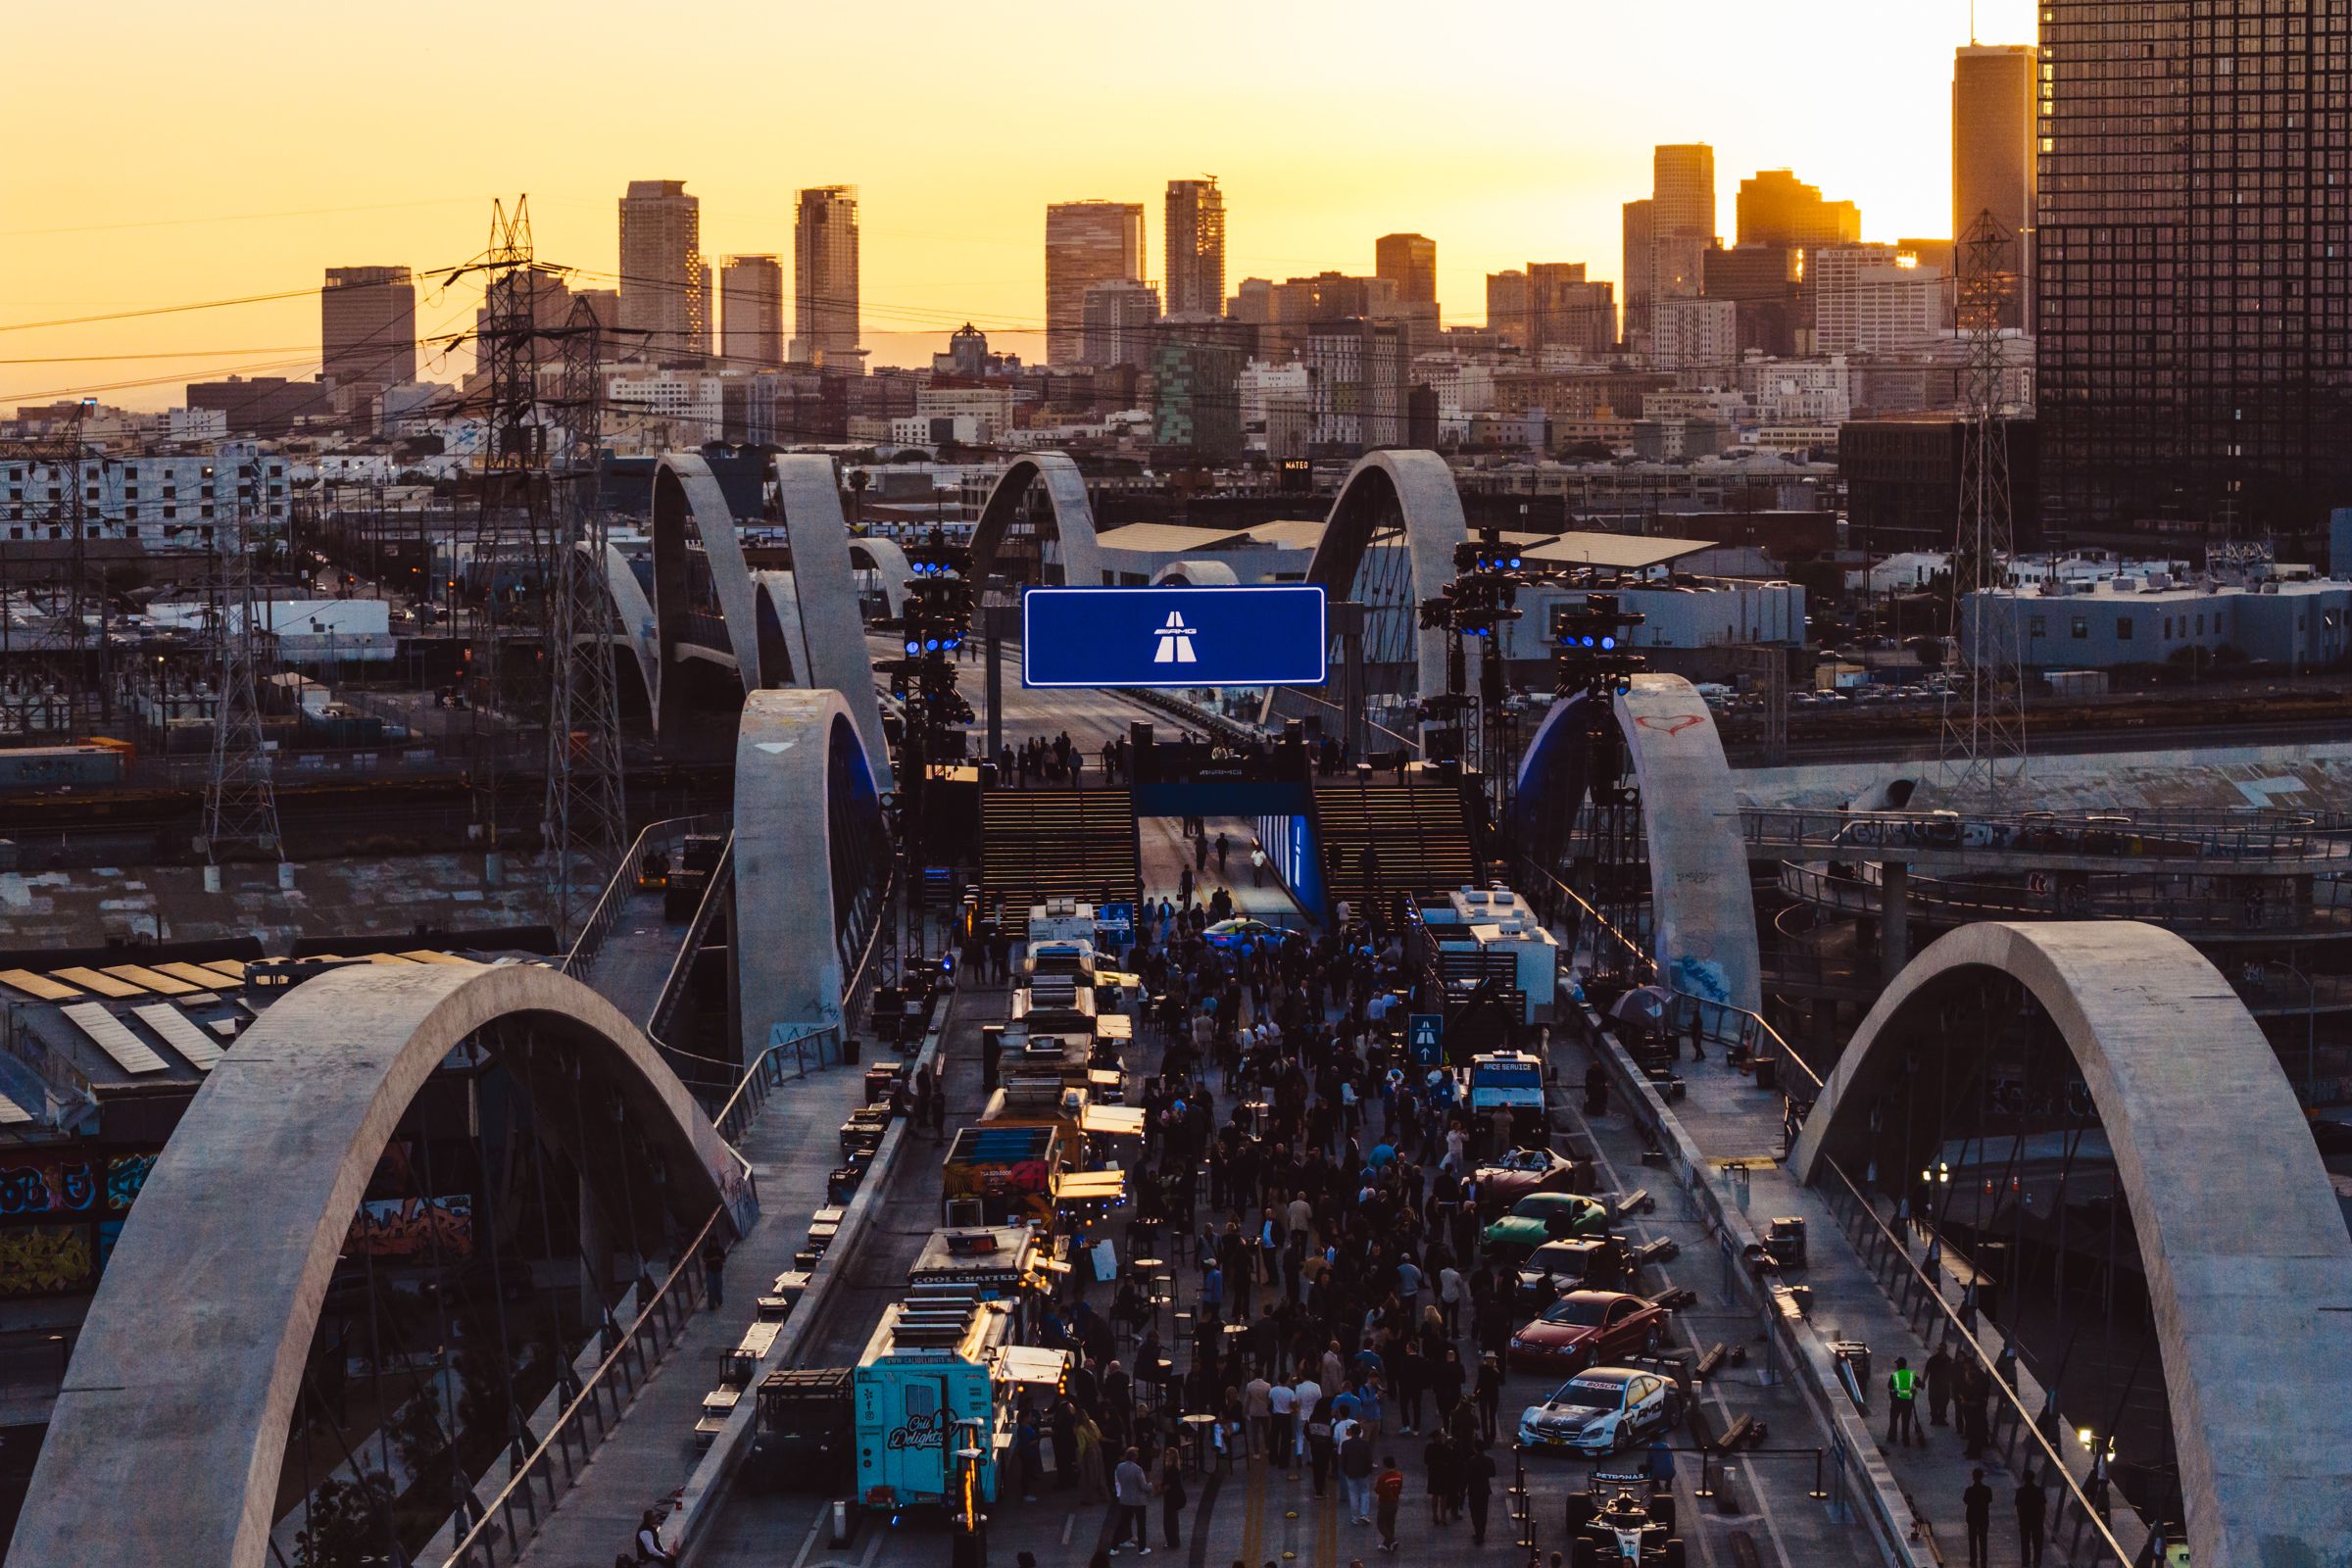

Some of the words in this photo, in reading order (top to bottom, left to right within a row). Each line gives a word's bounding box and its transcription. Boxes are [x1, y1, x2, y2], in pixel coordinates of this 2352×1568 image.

[1285, 461, 1308, 469] MATEO
[956, 1274, 1018, 1283] CRAFTED
[1637, 1400, 1663, 1421] AMG
